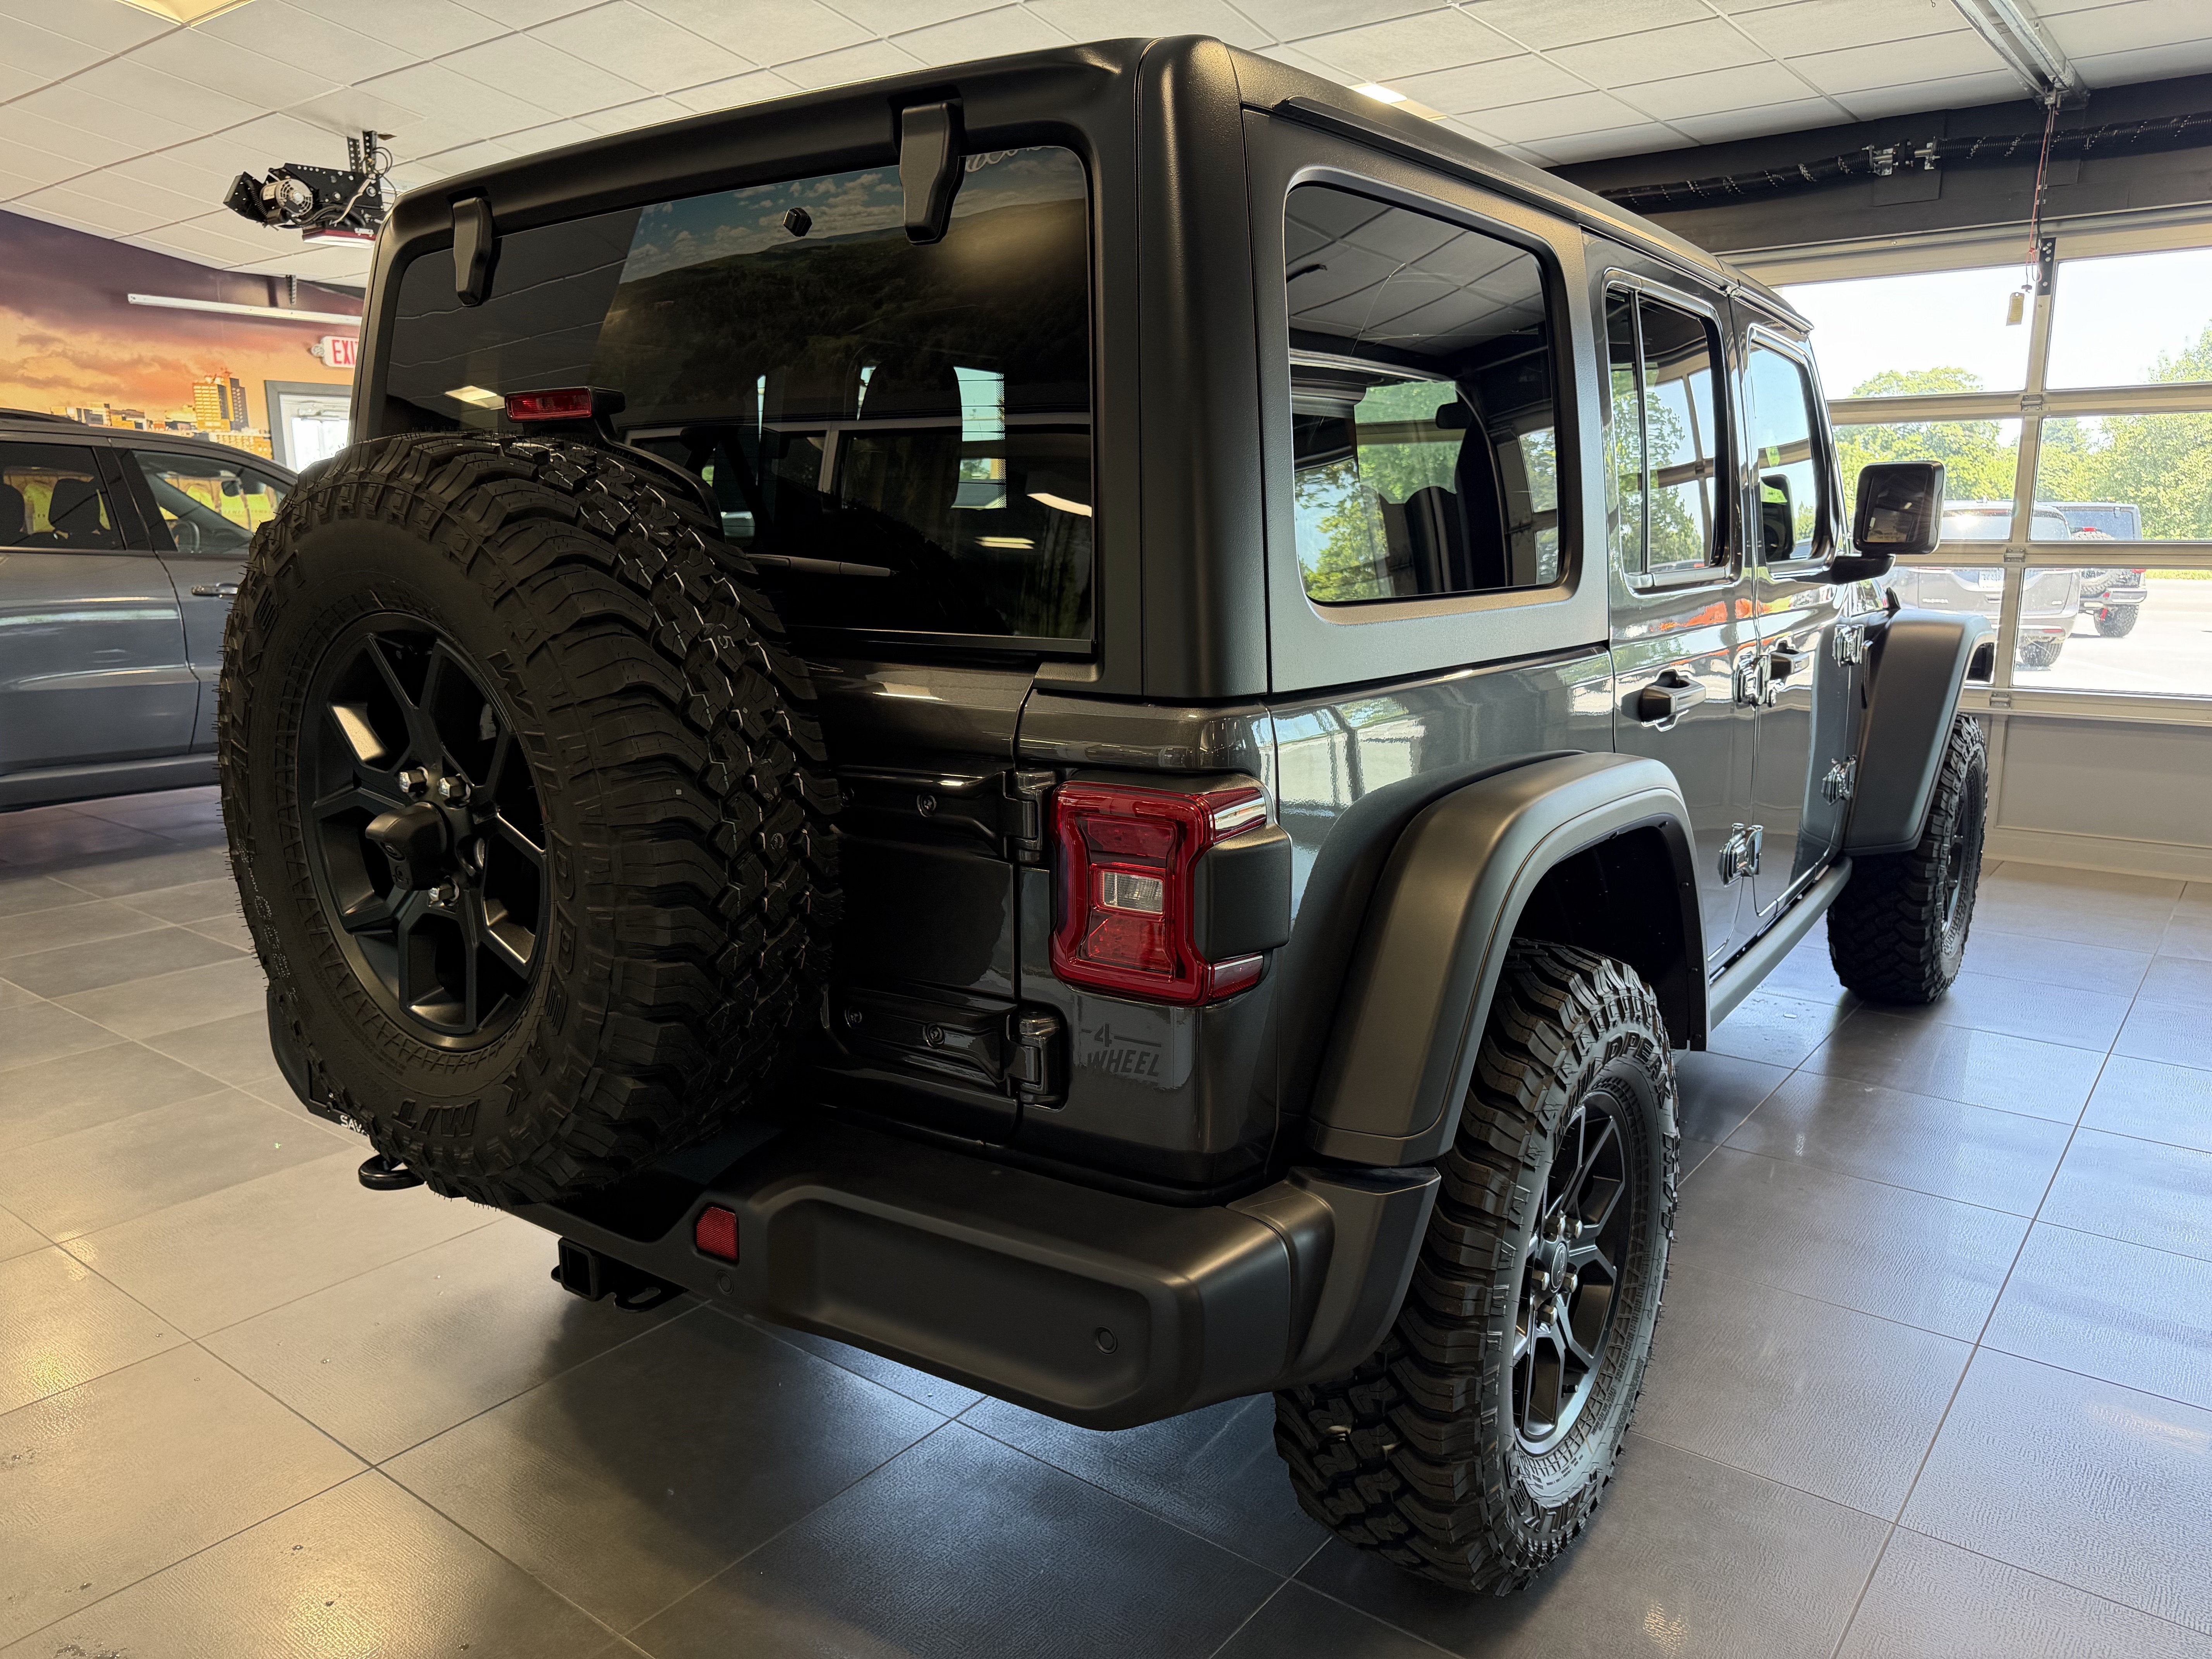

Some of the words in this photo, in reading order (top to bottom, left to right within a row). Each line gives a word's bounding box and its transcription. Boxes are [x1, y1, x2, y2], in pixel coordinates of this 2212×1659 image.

[332, 339, 359, 365] EXI
[1094, 1024, 1112, 1047] 4
[1087, 1049, 1160, 1077] WHEEL
